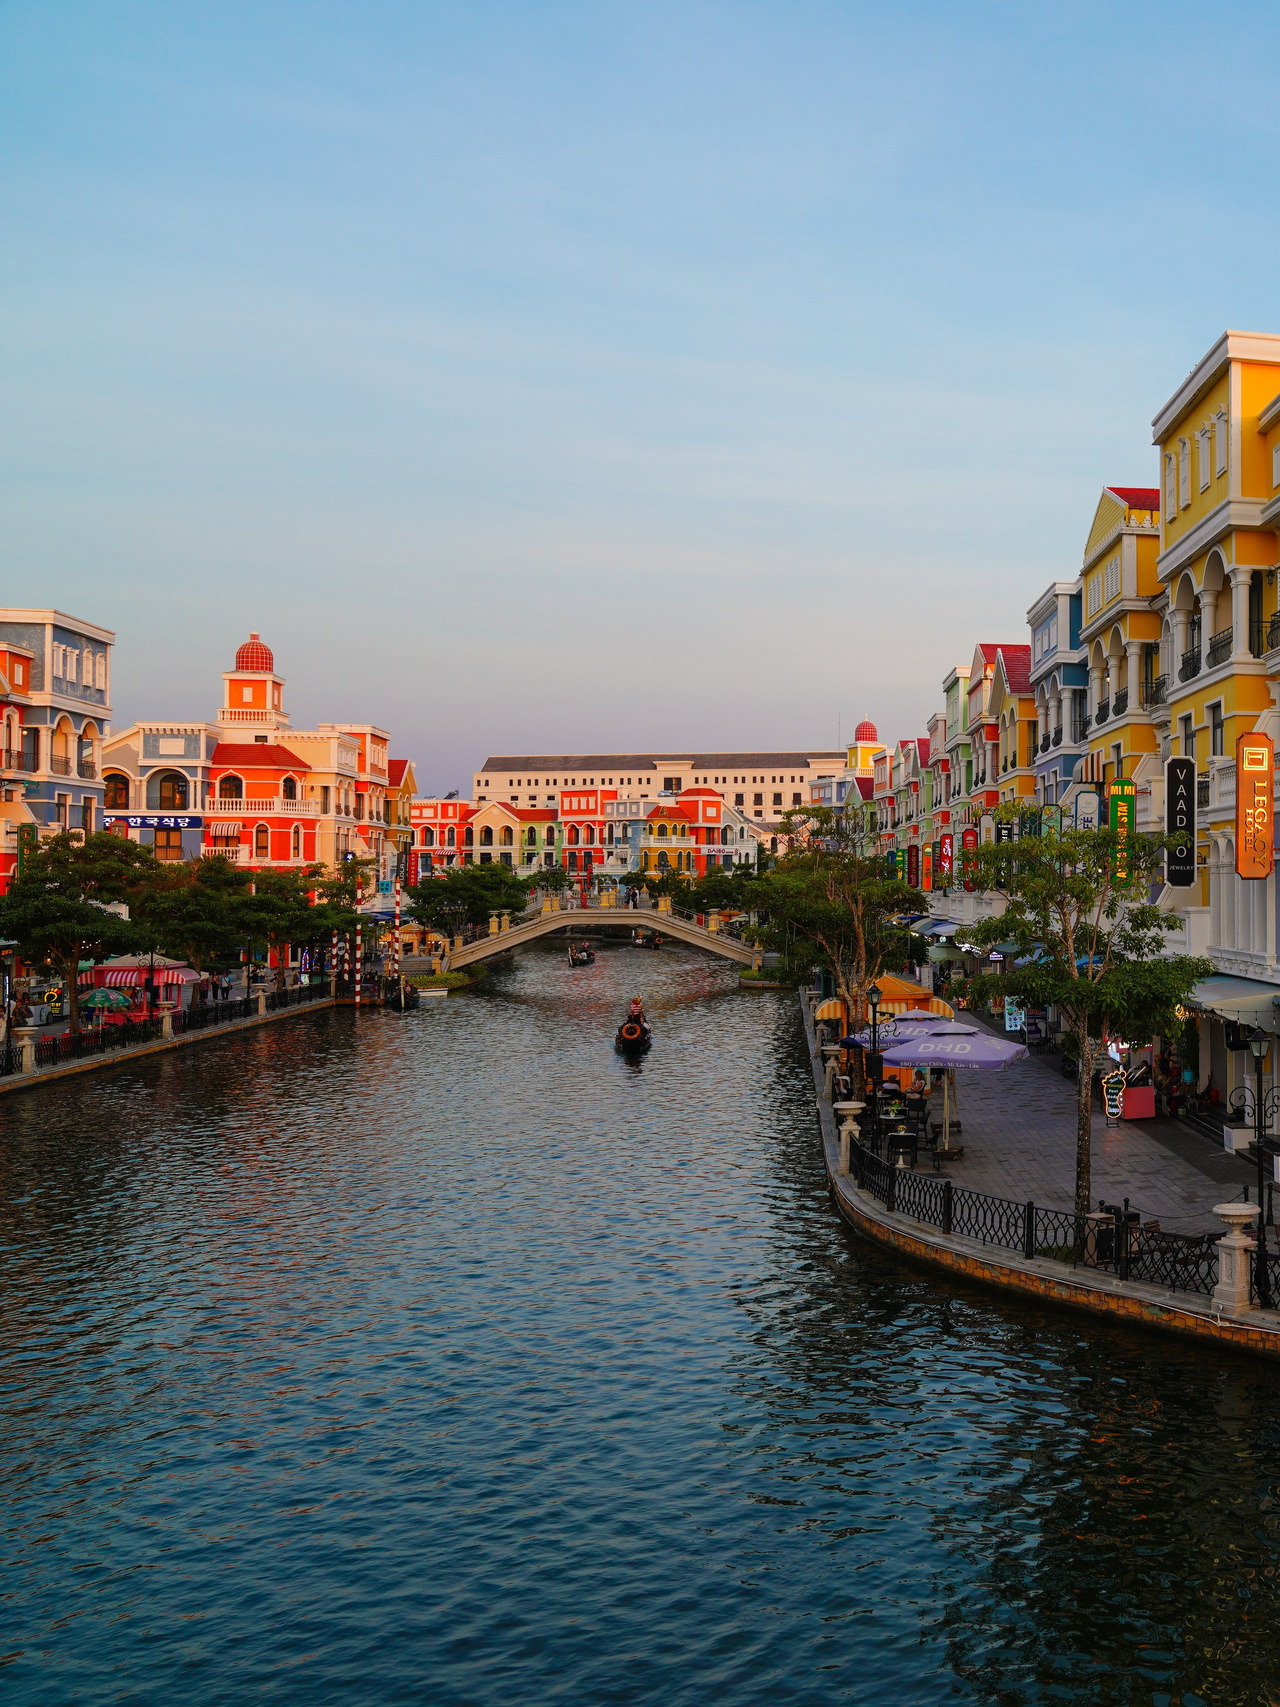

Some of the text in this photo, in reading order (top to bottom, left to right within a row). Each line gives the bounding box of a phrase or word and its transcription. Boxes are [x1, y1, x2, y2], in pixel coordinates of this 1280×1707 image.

[1111, 786, 1135, 795] MI MI
[1176, 768, 1187, 857] VAADO
[128, 817, 190, 827] 한국식당
[1244, 808, 1253, 852] HOTEL
[1254, 780, 1268, 868] LEGACY
[943, 838, 952, 856] Spa
[918, 1044, 971, 1054] DHD
